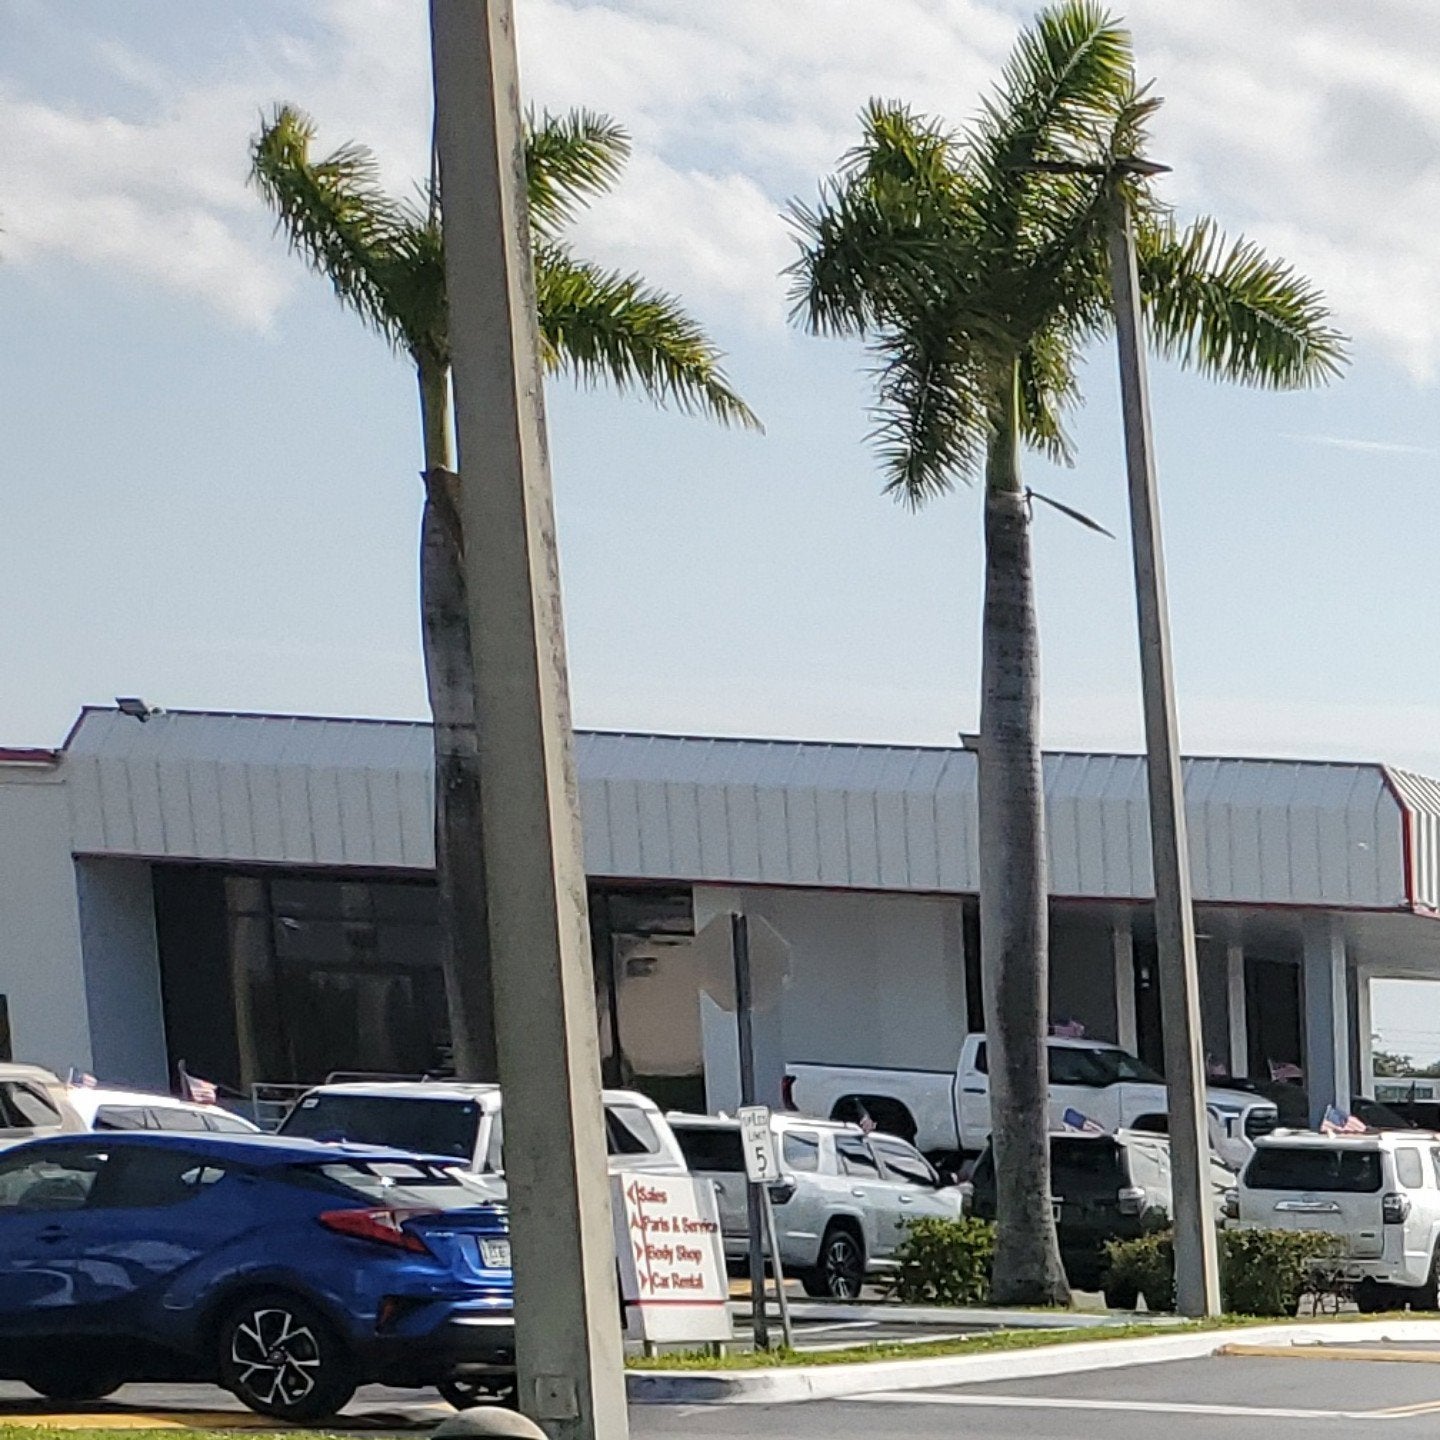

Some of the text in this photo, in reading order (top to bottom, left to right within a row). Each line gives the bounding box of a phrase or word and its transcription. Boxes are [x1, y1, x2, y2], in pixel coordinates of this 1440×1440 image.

[755, 1146, 768, 1172] 5
[638, 1186, 667, 1204] Sales
[641, 1215, 718, 1233] Parts & Service
[645, 1244, 702, 1265] Body Shop
[652, 1272, 704, 1289] Car Rental
